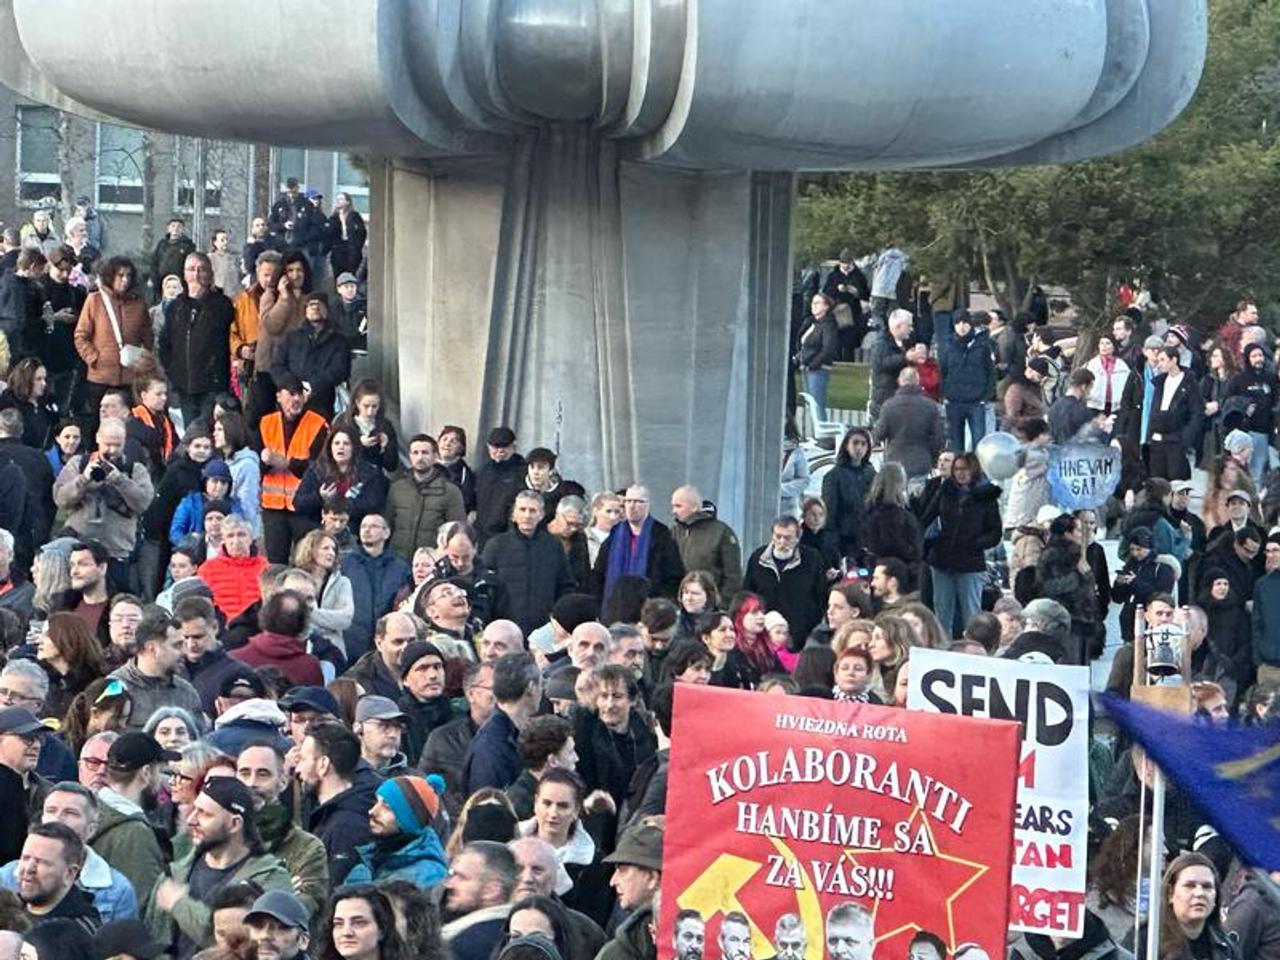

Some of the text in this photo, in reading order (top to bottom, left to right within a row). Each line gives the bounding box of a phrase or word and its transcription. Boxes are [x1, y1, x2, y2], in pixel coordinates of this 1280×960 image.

[775, 713, 909, 744] HVIEZDNA ROTA
[920, 668, 1074, 747] SEND
[706, 746, 974, 836] KOLABORANTI
[735, 801, 936, 857] HANBÍME SA
[1014, 803, 1073, 836] EARS
[765, 854, 895, 901] ZA VÁS!!!
